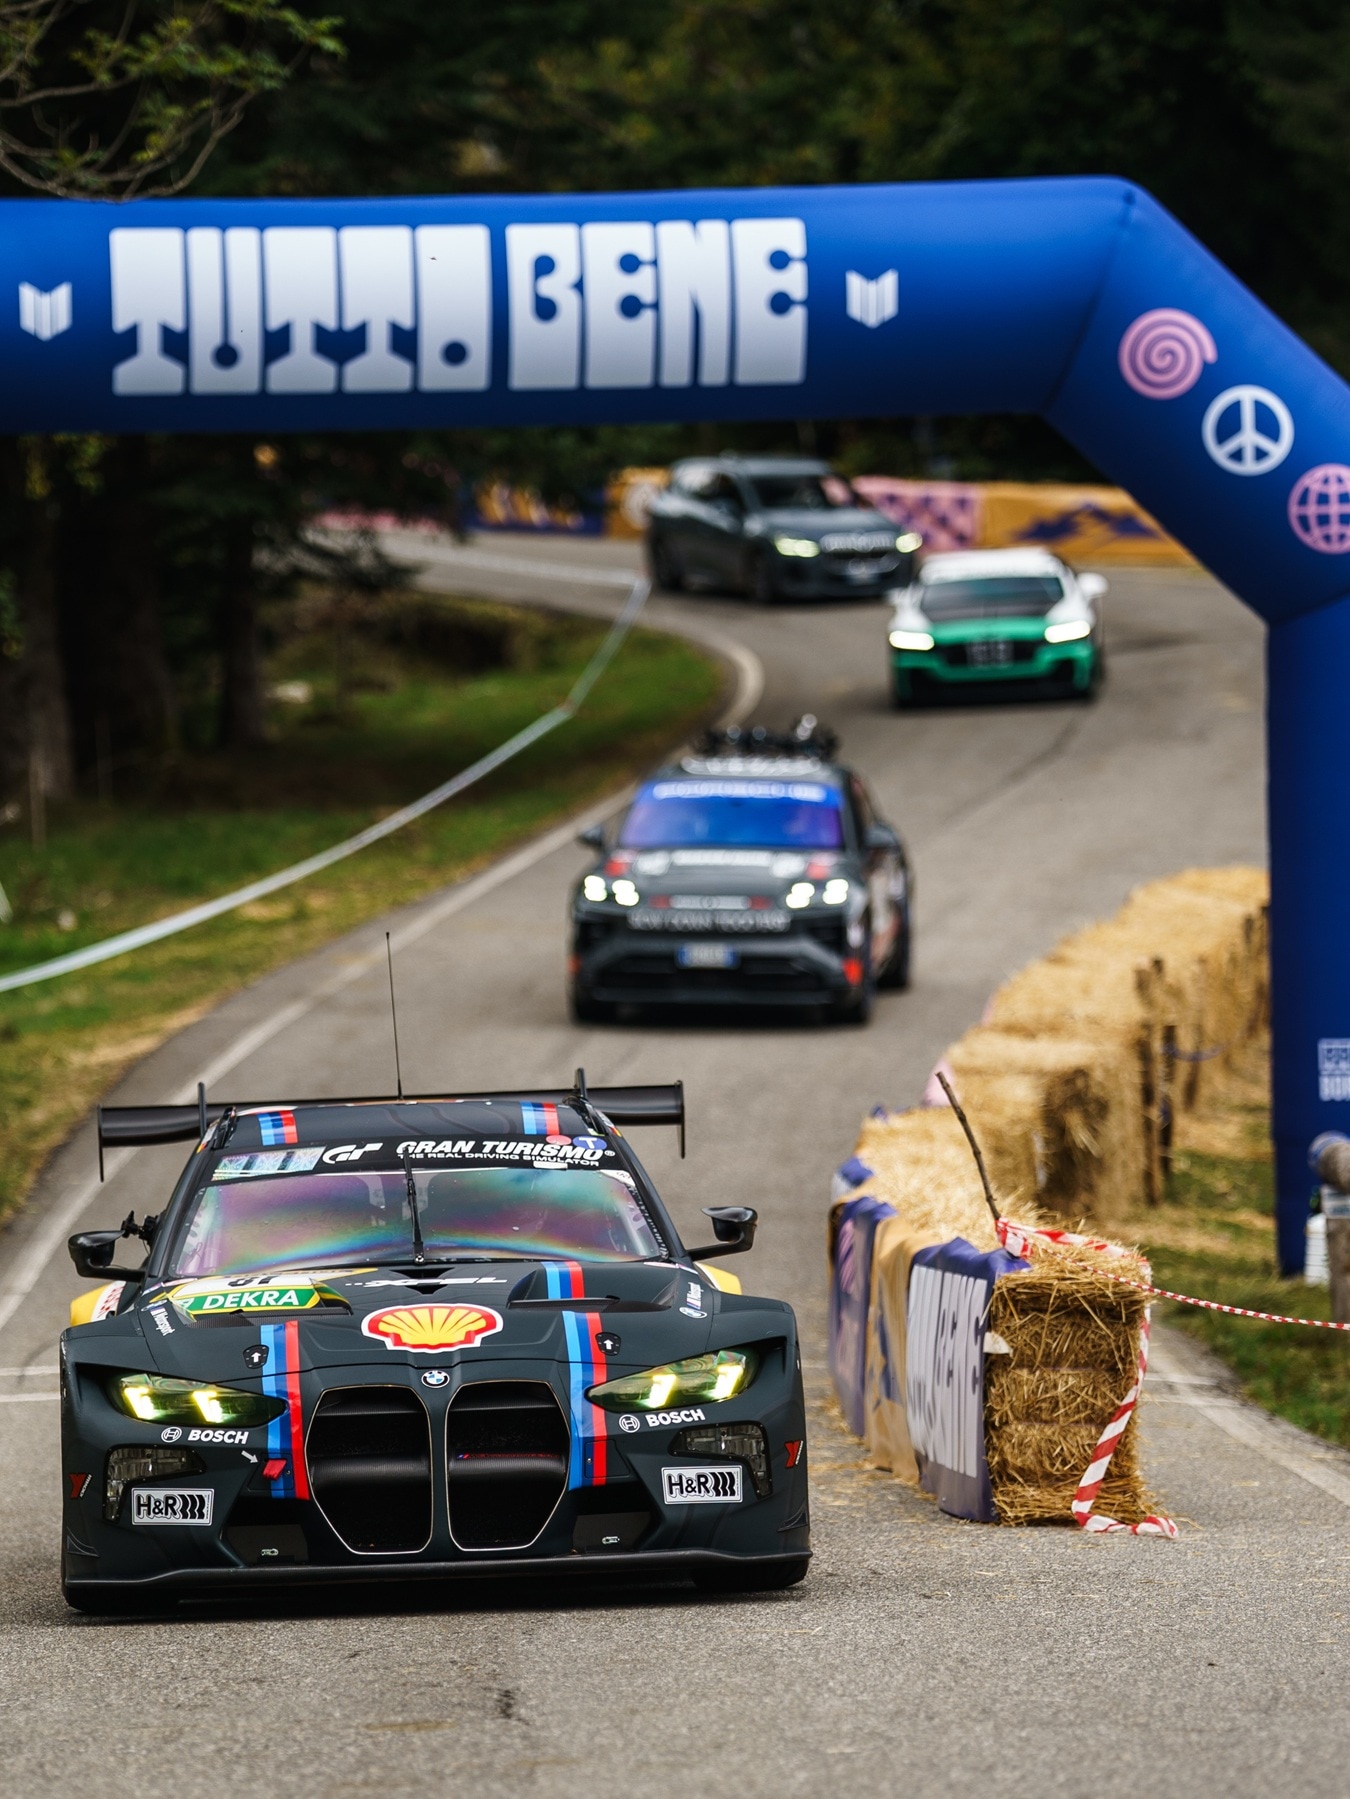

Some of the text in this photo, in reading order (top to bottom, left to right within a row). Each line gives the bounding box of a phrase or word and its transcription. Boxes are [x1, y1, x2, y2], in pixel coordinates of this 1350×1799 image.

[109, 217, 809, 396] TUTTO BENE
[322, 1142, 383, 1164] GT
[396, 1140, 476, 1154] GRAN
[465, 1152, 520, 1160] DRIVING
[522, 1155, 600, 1167] SIMULATOR
[202, 1289, 300, 1310] DEKRA
[645, 1408, 706, 1427] BOSCH
[188, 1430, 249, 1444] BOSCH
[667, 1472, 713, 1498] H&R
[136, 1494, 179, 1519] H&R
